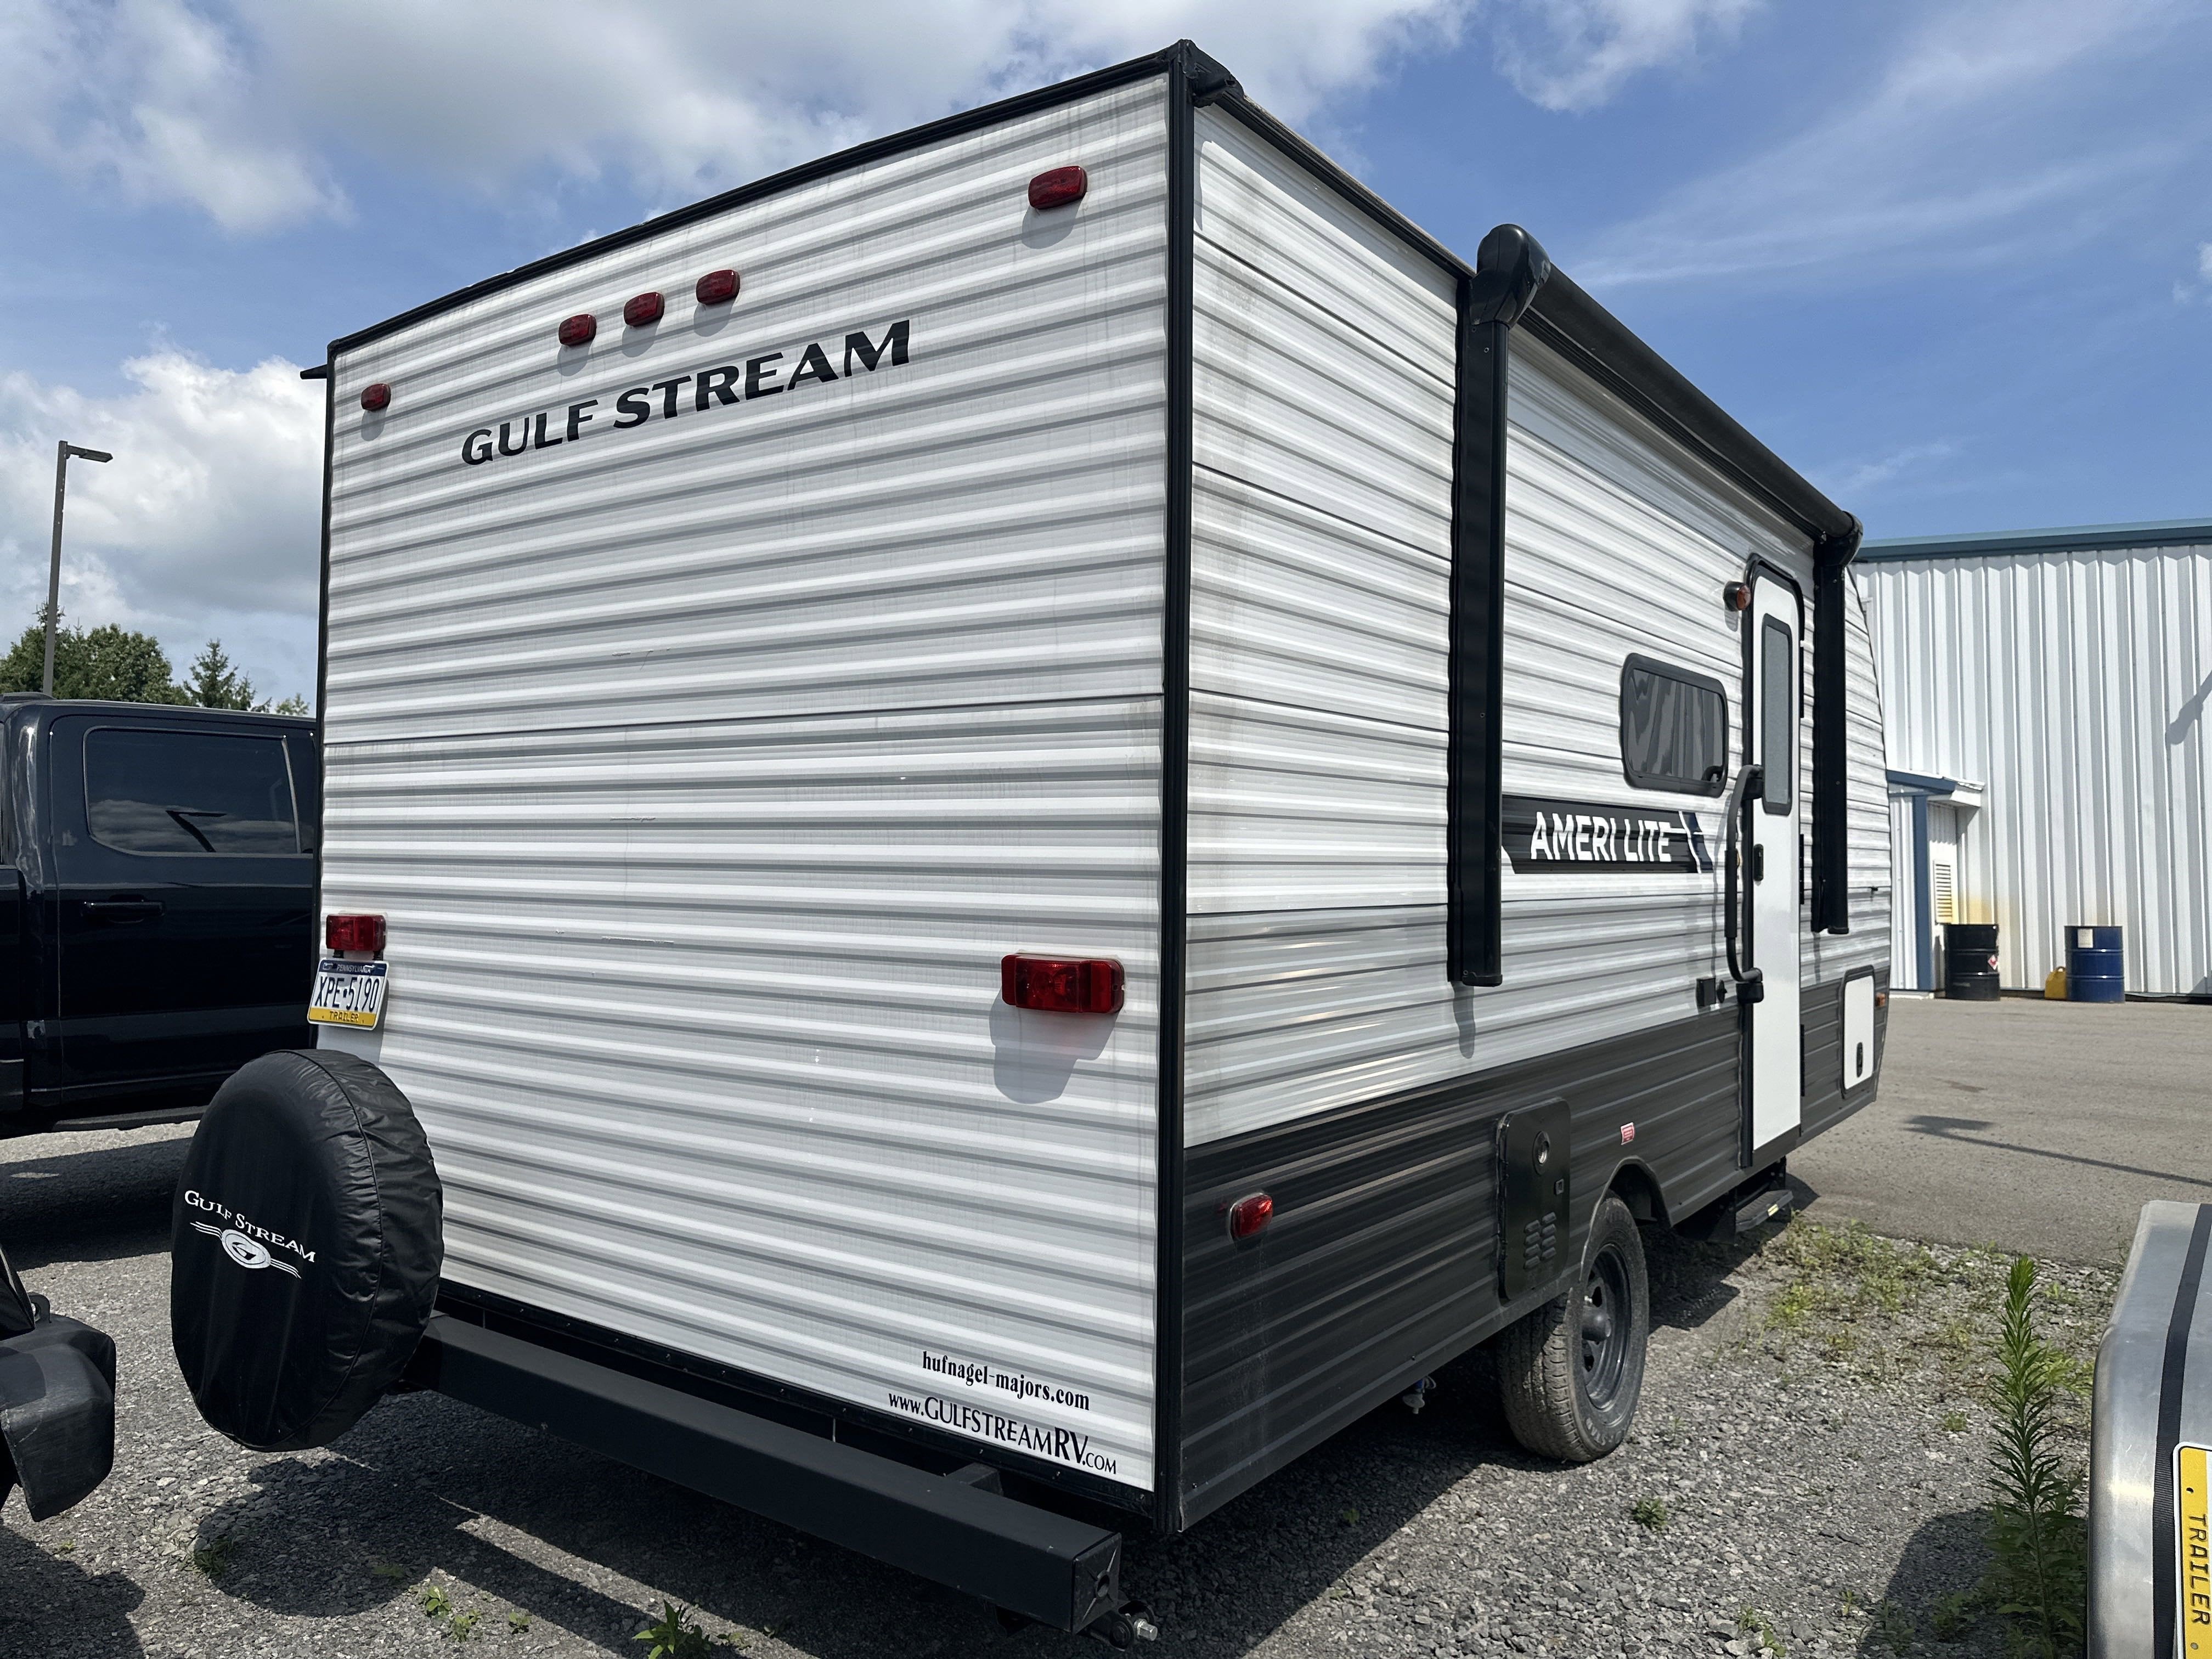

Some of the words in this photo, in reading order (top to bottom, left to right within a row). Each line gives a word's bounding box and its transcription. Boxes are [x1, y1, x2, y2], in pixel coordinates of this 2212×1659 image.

[461, 399, 598, 465] GULF
[613, 319, 910, 428] STREAM
[1531, 811, 1617, 861] AMERI
[1624, 819, 1672, 862] LITE
[329, 1011, 359, 1023] TRAILER
[922, 1351, 1090, 1410] hufnagel-majors.com
[2188, 1514, 2210, 1626] TRAILER
